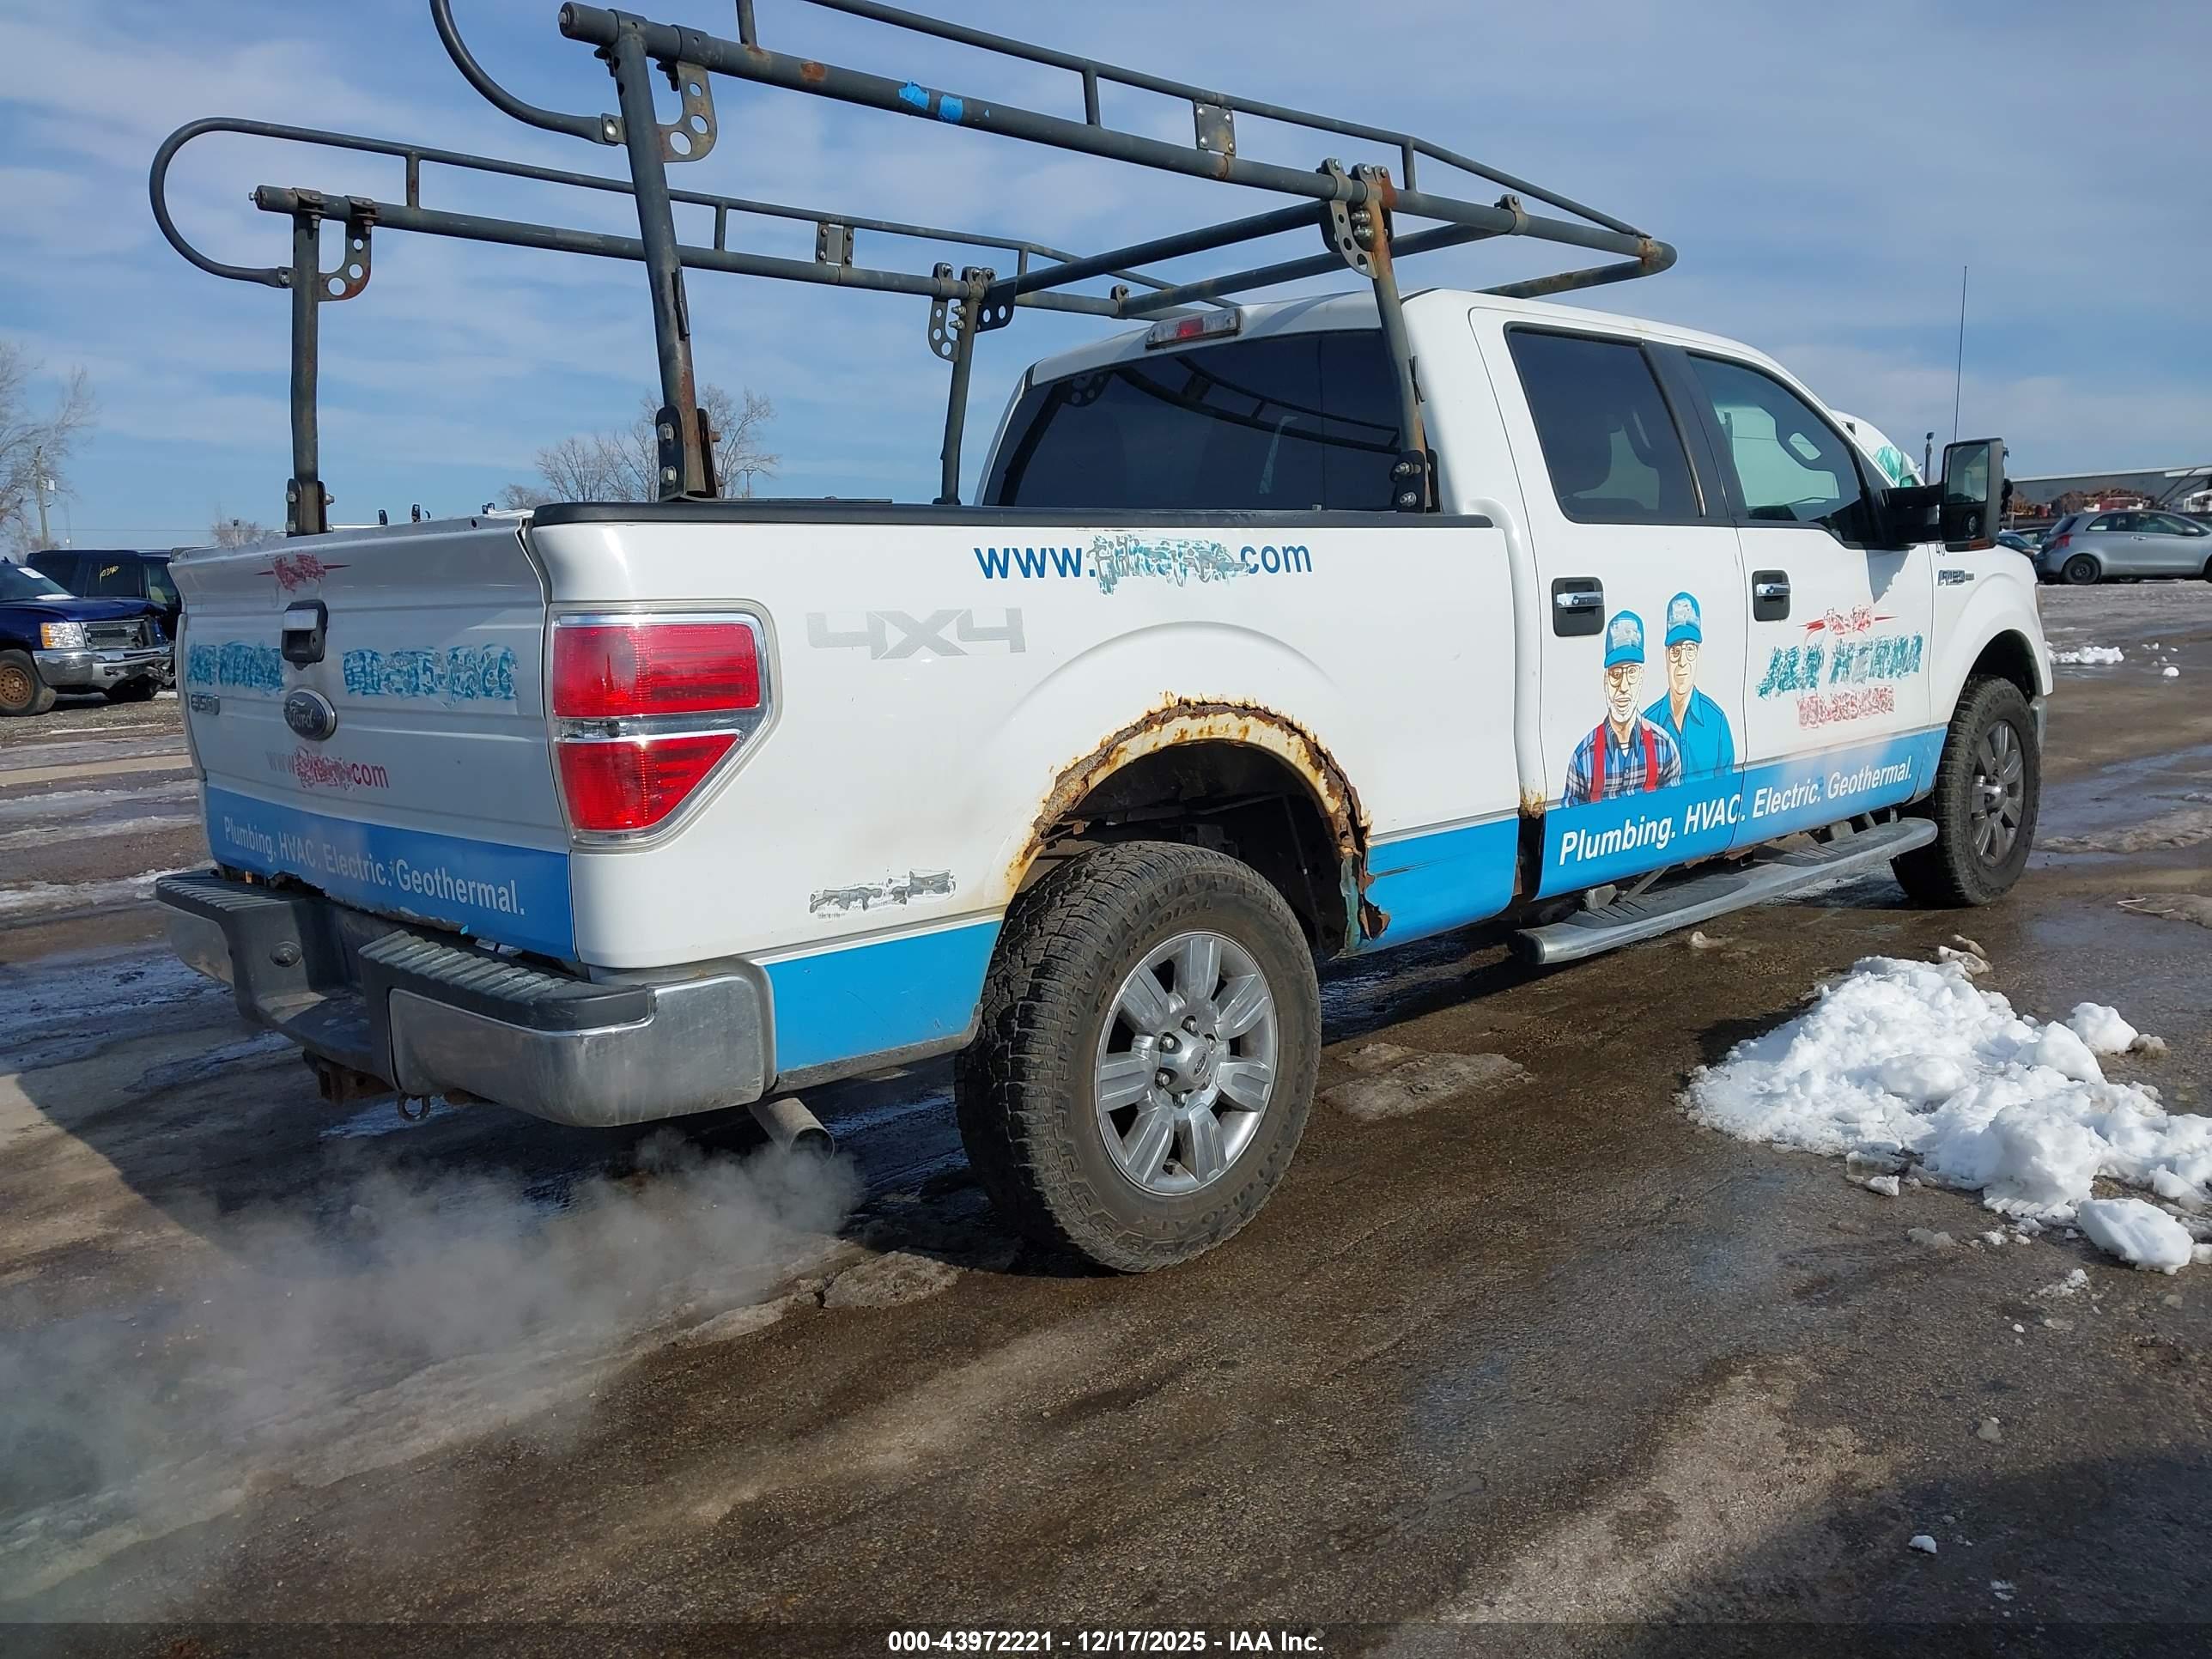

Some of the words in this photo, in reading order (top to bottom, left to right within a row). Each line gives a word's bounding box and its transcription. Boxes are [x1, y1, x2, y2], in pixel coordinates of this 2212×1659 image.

[289, 699, 314, 729] Ford
[1559, 815, 1676, 866] Plumbing.
[1683, 793, 1746, 836] HVAC.
[1753, 777, 1821, 818] Electric.
[1827, 755, 1912, 800] Geothermal.
[223, 815, 276, 863] Plumbing.
[323, 842, 392, 887] Electric.
[396, 858, 526, 916] Geothermal.
